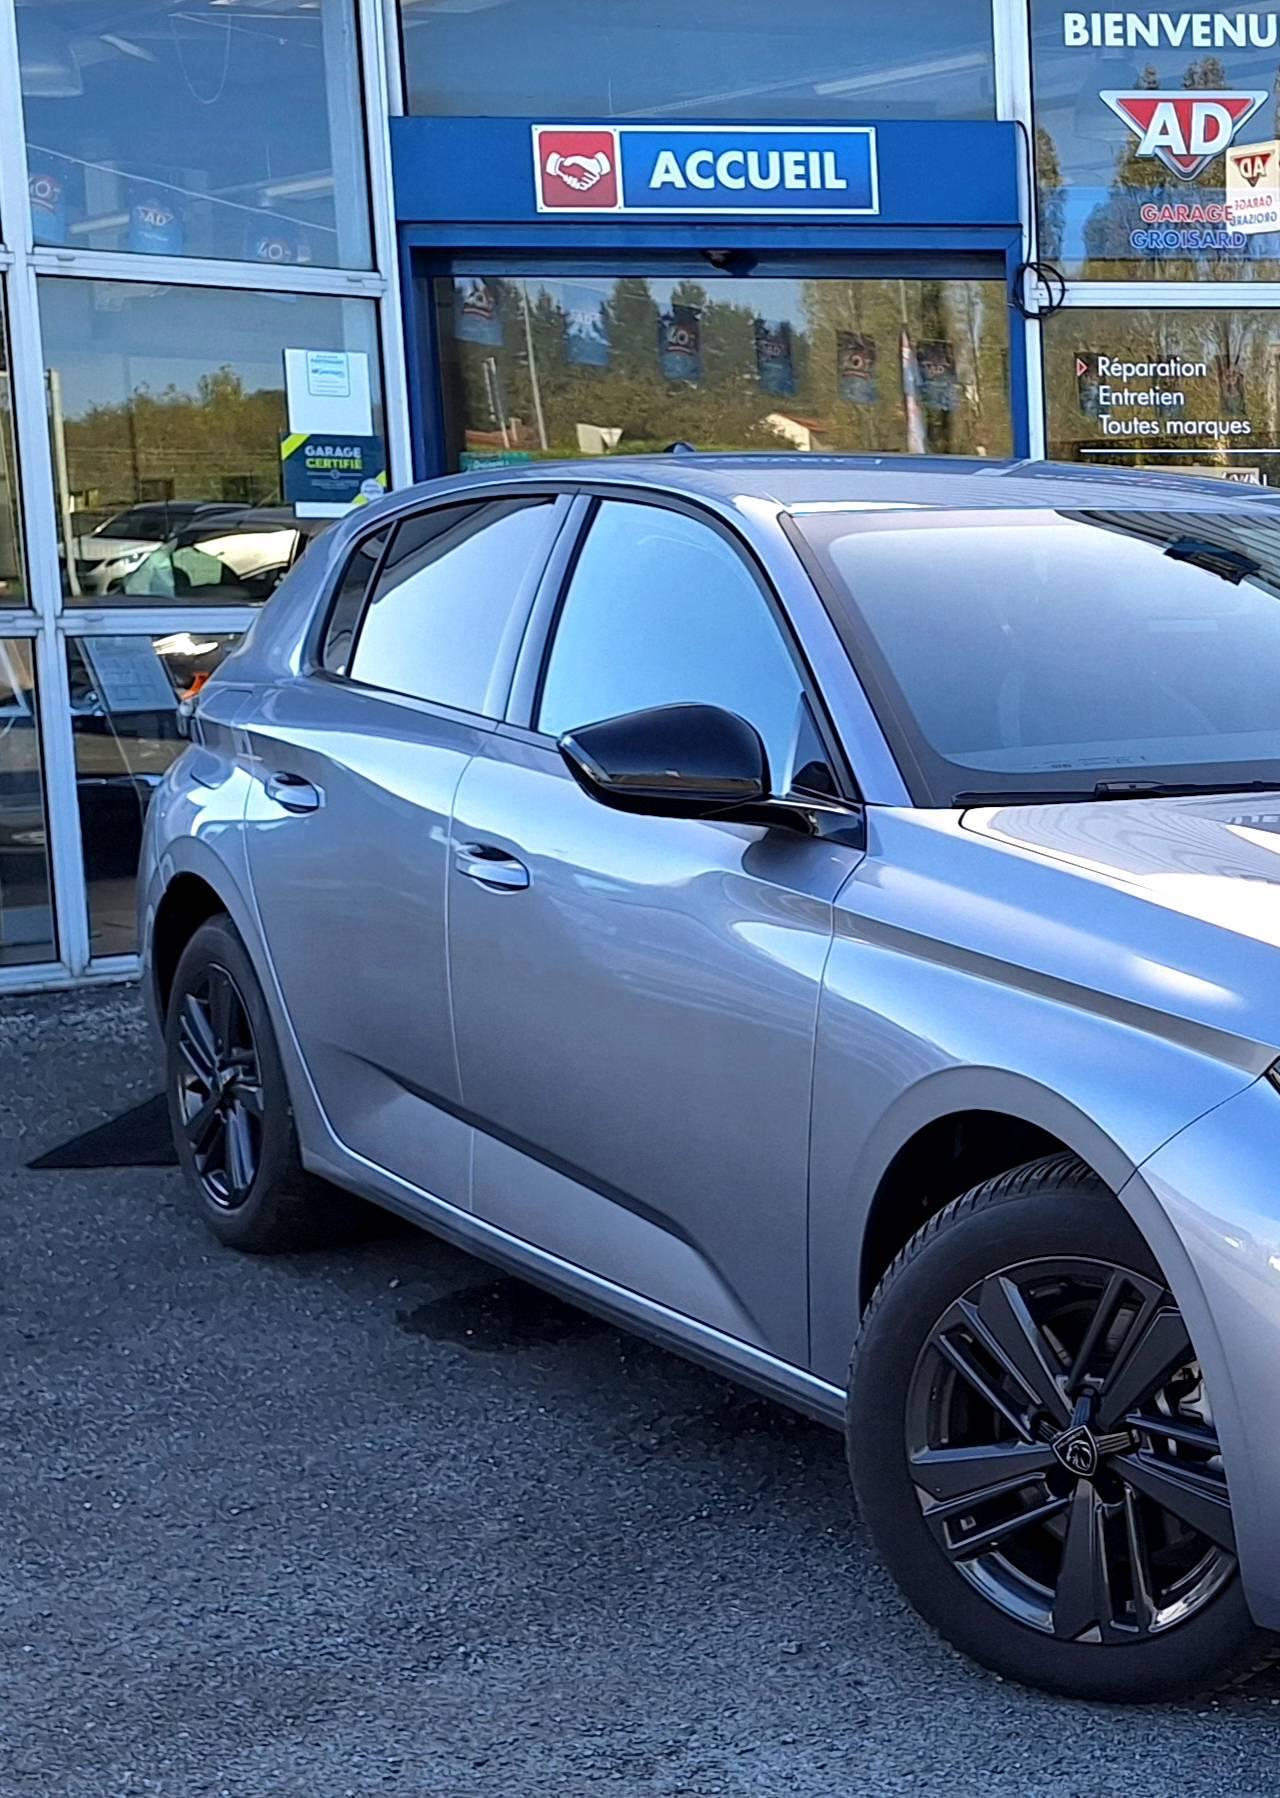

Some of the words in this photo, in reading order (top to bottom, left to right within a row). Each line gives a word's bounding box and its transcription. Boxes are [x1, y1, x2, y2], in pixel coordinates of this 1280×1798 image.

[1137, 102, 1234, 157] AD
[648, 150, 848, 190] ACCUEIL
[1141, 204, 1233, 223] GARAGE
[1130, 230, 1247, 249] GROISARD
[1098, 357, 1207, 382] Réparation
[1099, 386, 1184, 406] Entretien
[1099, 415, 1159, 435] Toutes
[1166, 418, 1251, 440] marques
[304, 445, 361, 457] GARAGE
